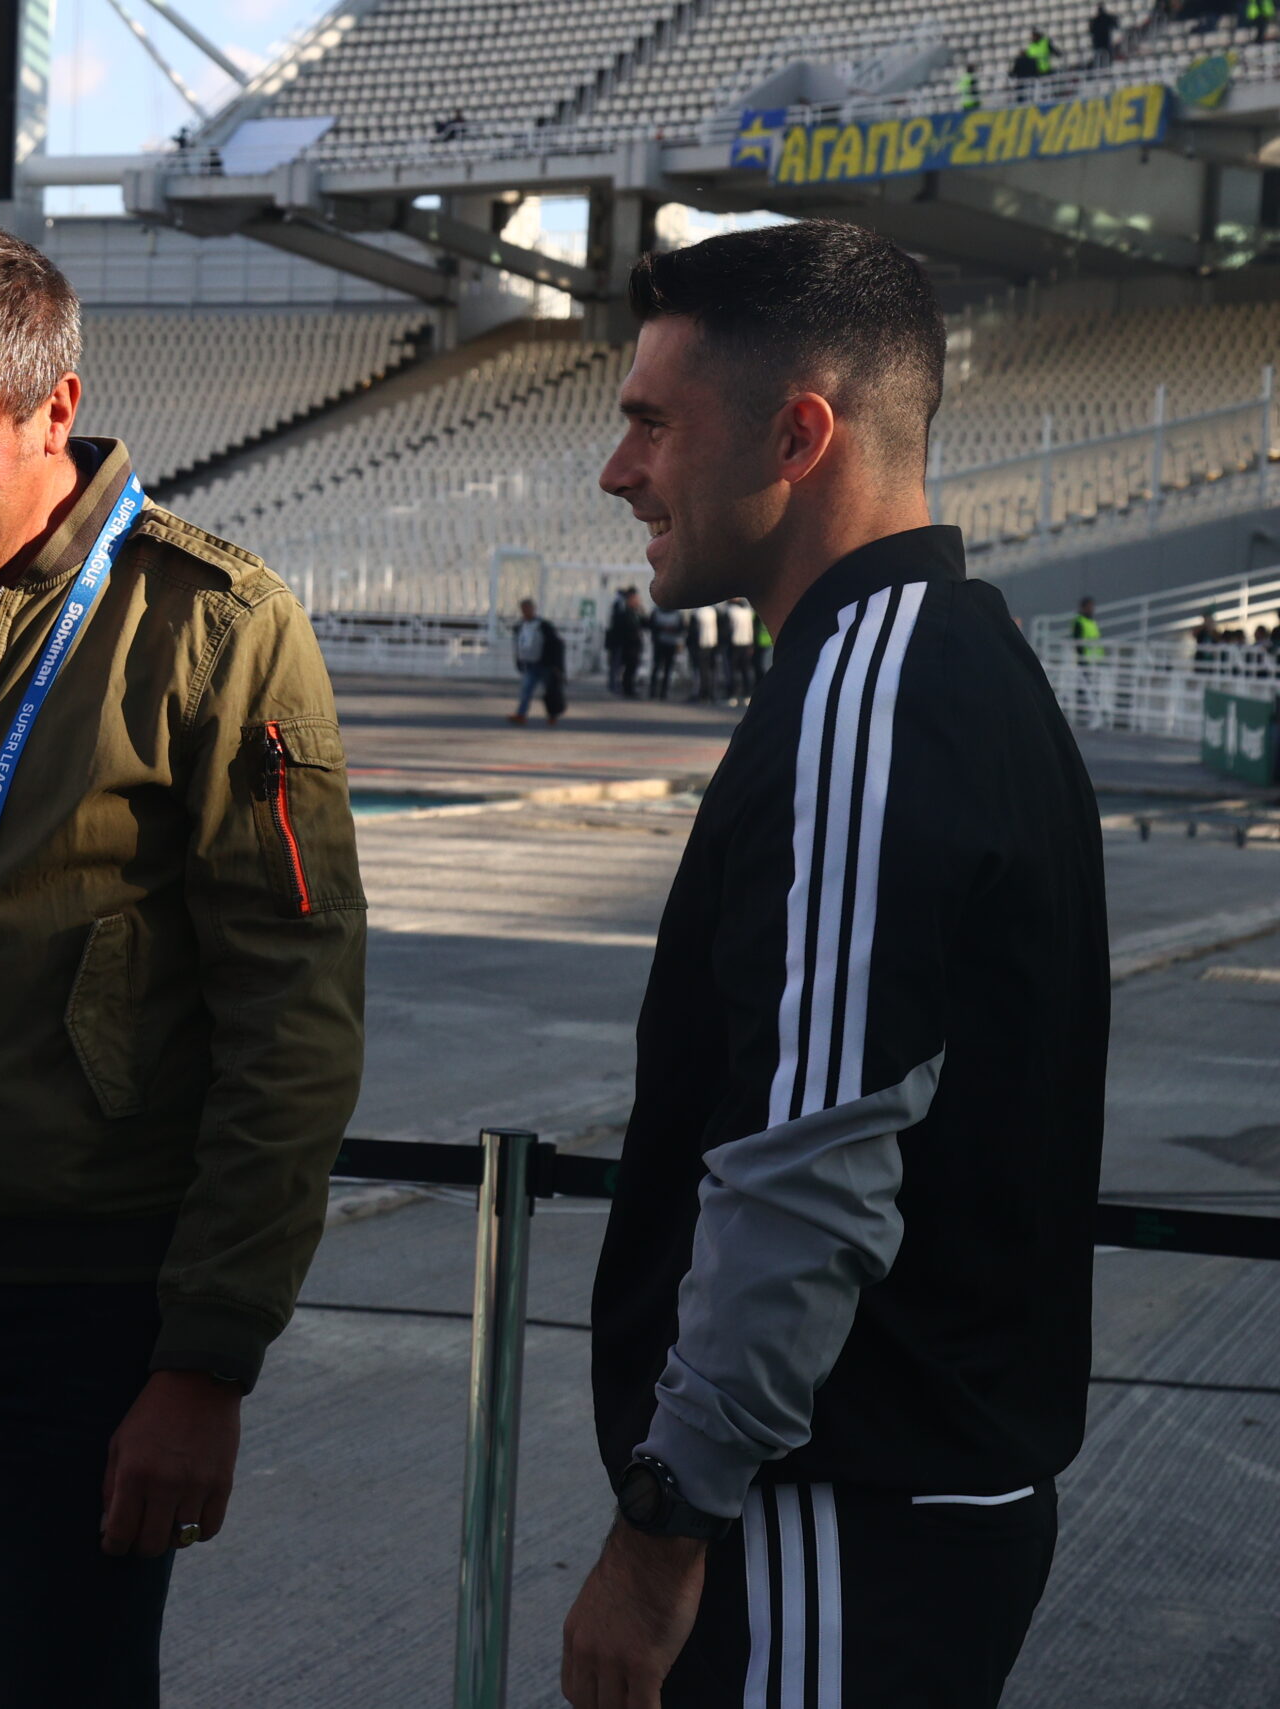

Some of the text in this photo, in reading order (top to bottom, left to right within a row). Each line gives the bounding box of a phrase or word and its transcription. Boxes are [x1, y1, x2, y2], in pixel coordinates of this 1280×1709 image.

[778, 84, 1164, 184] ΑΓΑΠΩ ΣΗΜΑΙΝΕΙ
[108, 497, 136, 535] SUPER
[81, 534, 116, 588] LEAGUE
[34, 601, 84, 687] Stoiximan
[5, 703, 34, 751] SUPER
